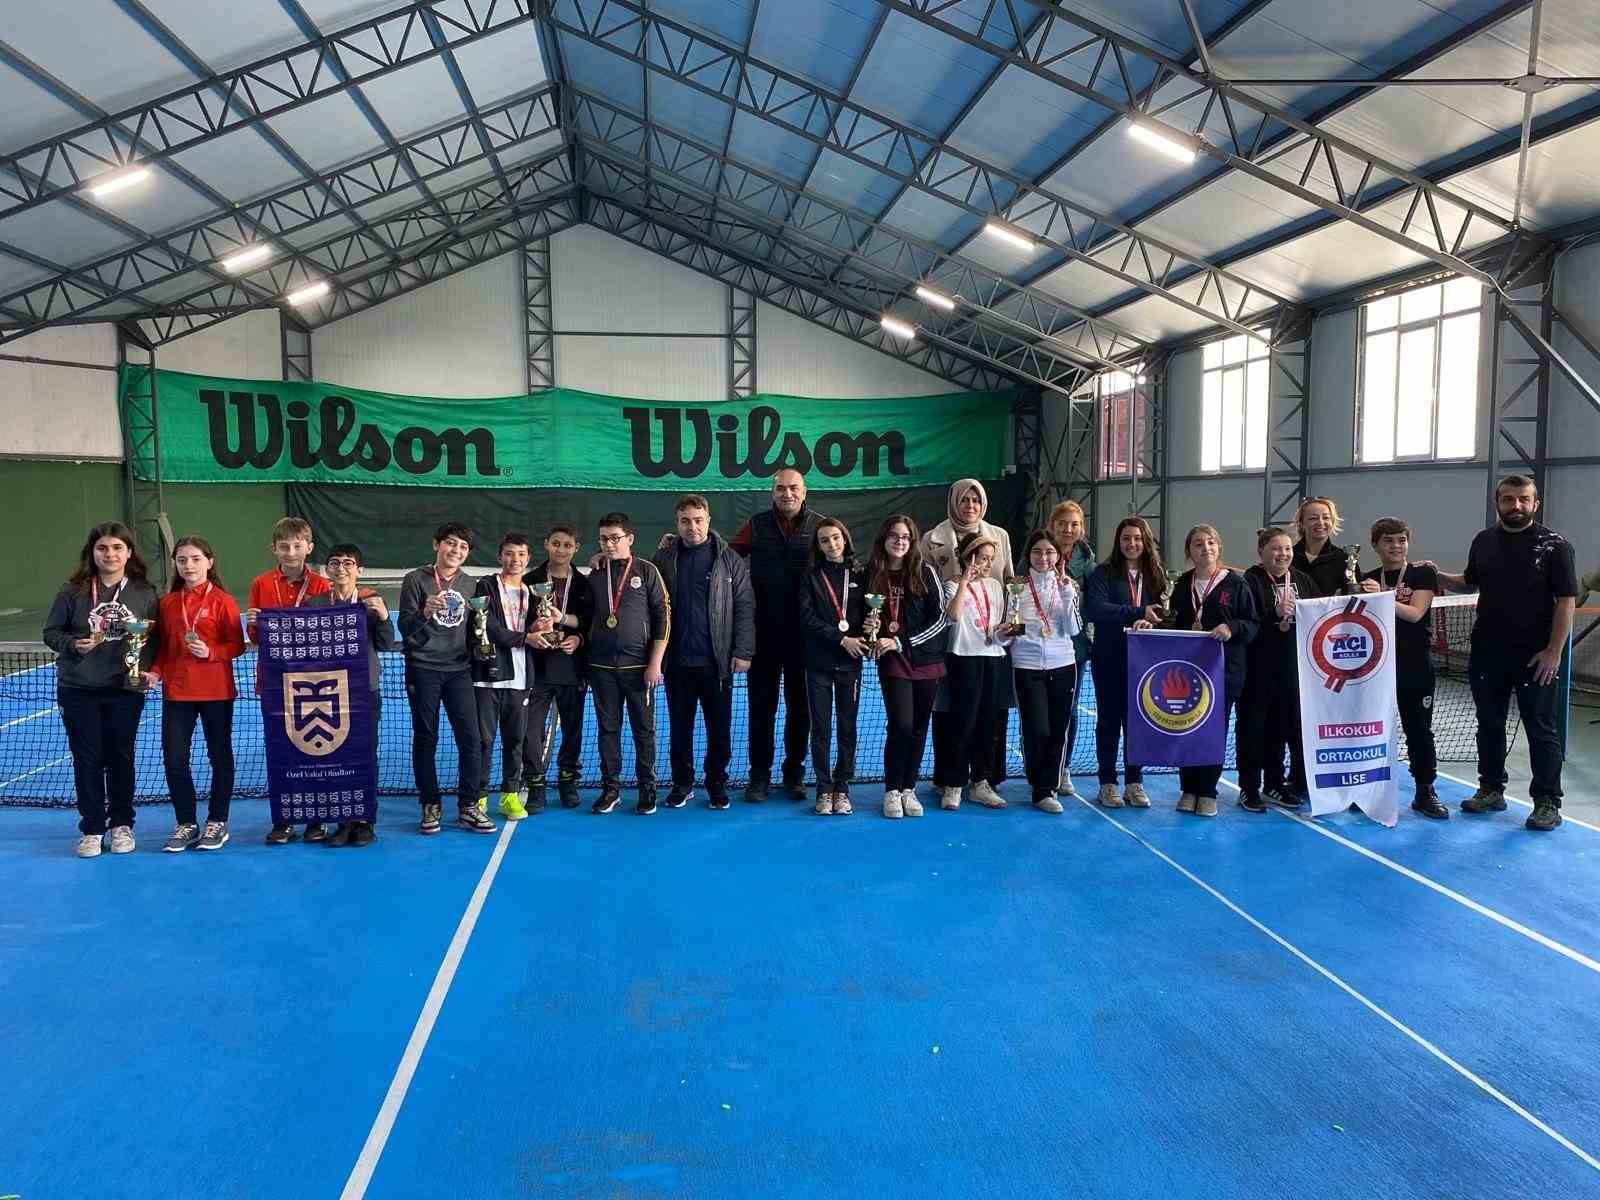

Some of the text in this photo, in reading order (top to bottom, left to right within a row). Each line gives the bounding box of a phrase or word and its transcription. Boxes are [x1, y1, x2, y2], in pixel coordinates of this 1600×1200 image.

[200, 389, 500, 476] Wilson
[623, 405, 910, 479] Wilson
[1318, 747, 1384, 761] ORTAOKUL
[1341, 773, 1367, 785] LİSE
